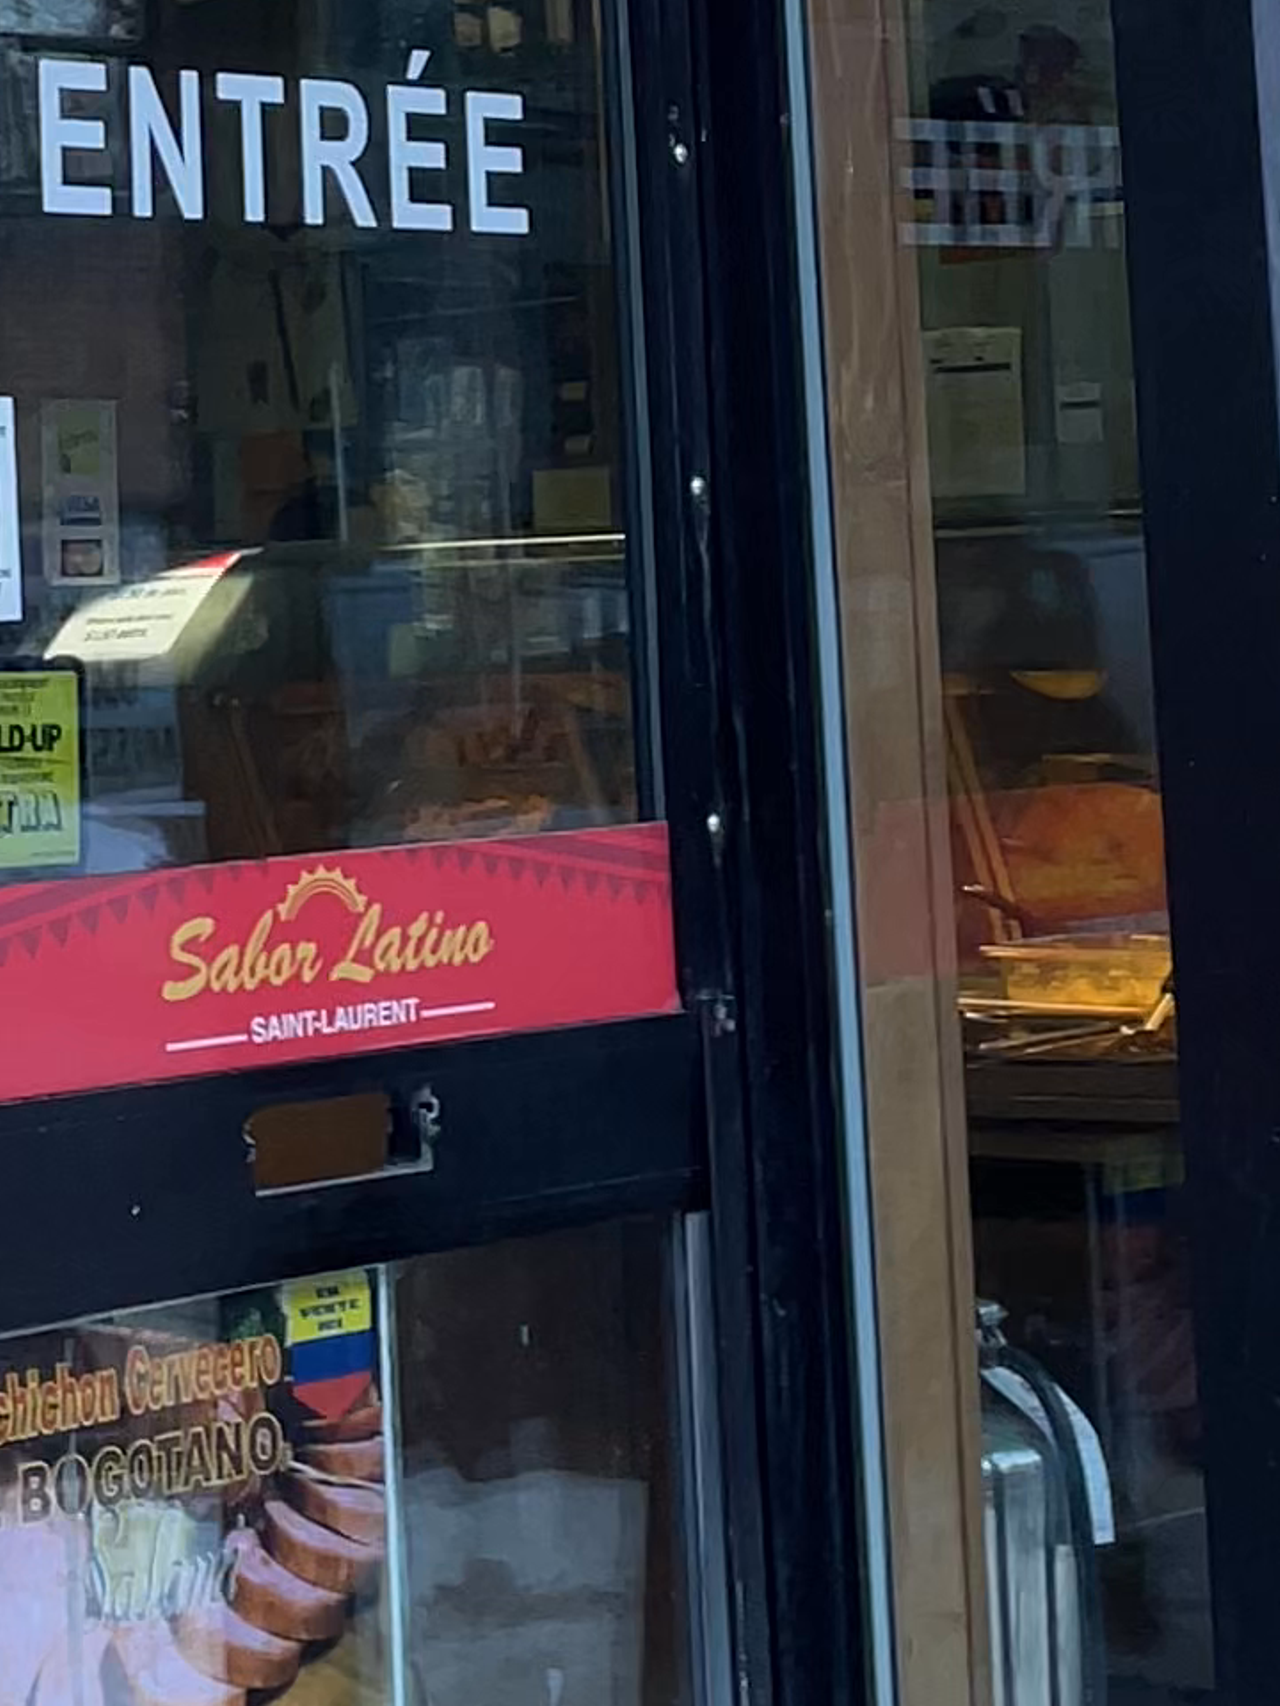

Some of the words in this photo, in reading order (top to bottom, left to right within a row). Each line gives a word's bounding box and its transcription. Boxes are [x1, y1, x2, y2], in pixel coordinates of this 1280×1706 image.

[37, 50, 530, 235] ENTRÉE
[161, 908, 322, 1002] Sabor
[329, 902, 494, 983] Latino
[250, 997, 420, 1045] SAINT-LAURENT
[124, 1334, 282, 1416] Cervecero
[17, 1411, 285, 1526] BOGOTANO
